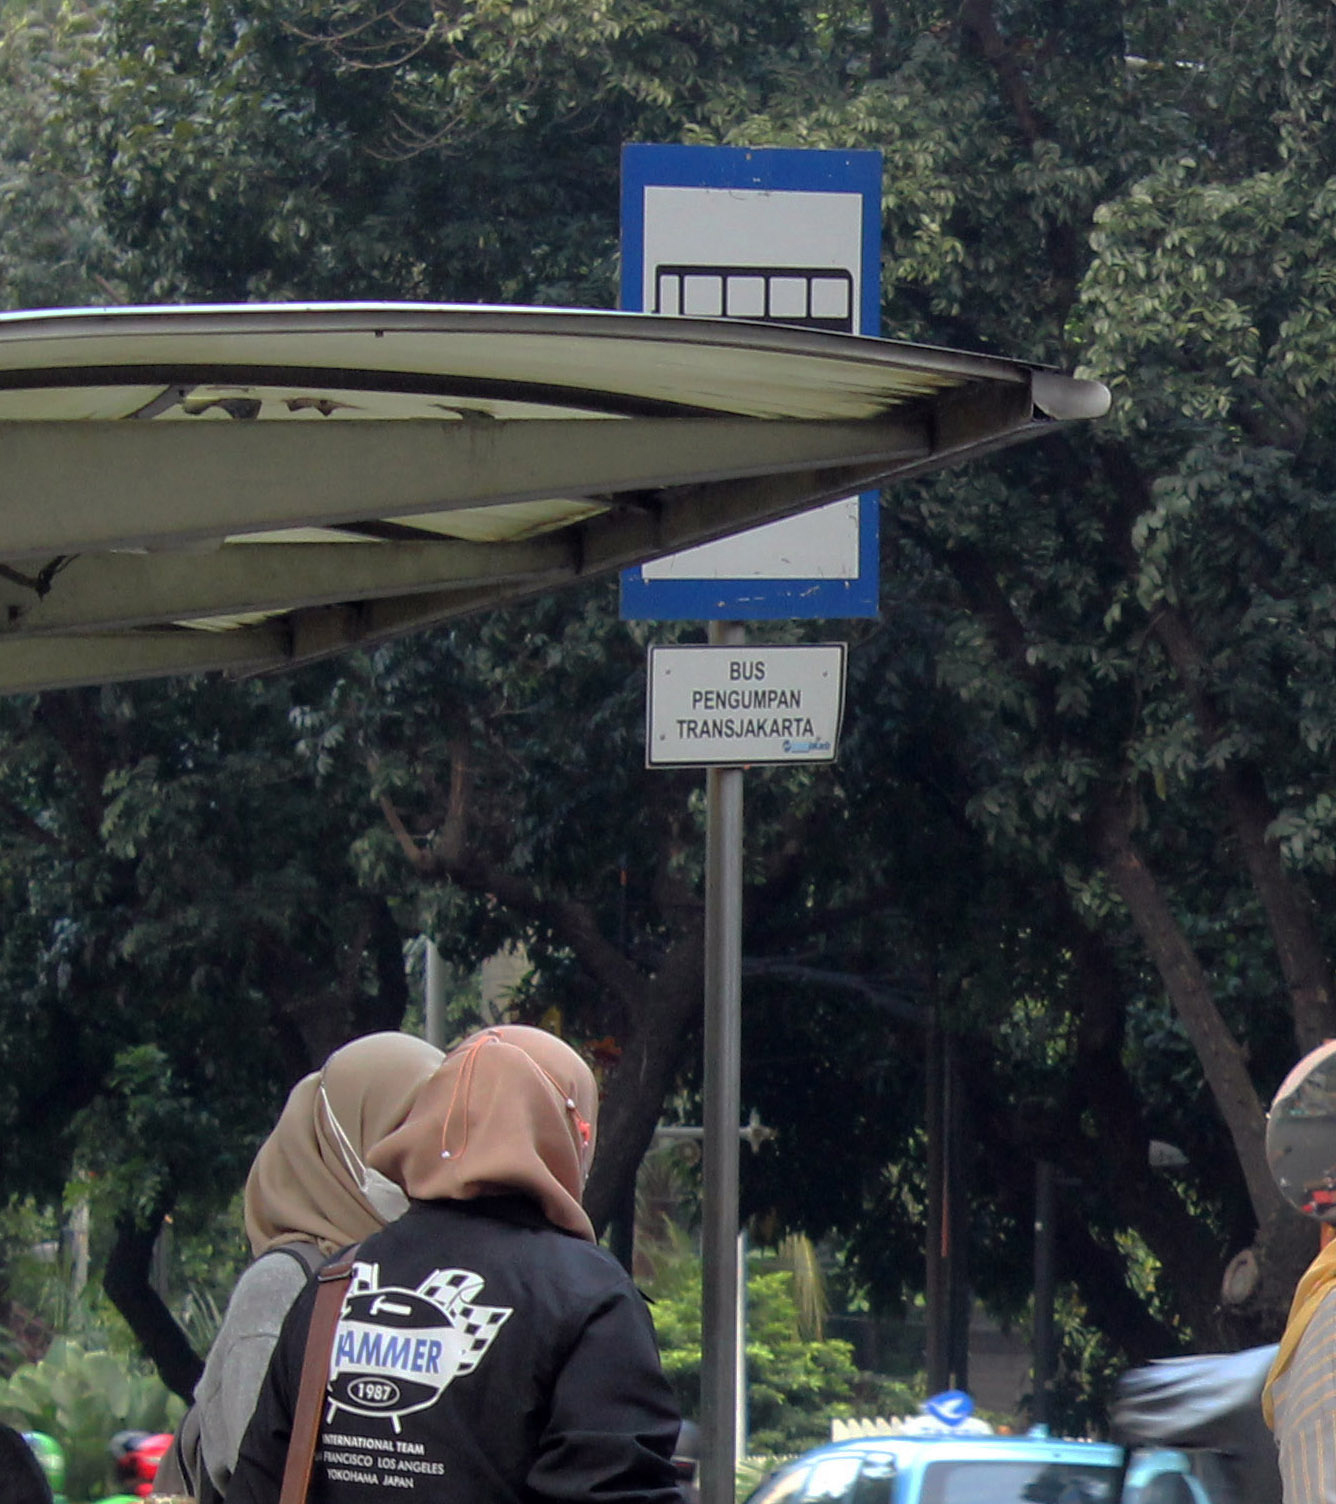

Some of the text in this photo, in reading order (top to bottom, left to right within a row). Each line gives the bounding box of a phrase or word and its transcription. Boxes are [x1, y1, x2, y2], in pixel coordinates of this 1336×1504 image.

[729, 661, 765, 681] BUS
[692, 690, 801, 710] PENGUMPAN
[676, 718, 814, 739] TRANSJAKARTA
[358, 1383, 392, 1400] 1987
[395, 1441, 425, 1456] TEAM
[323, 1450, 373, 1467] FRANCISCO
[377, 1457, 396, 1470] LOS
[397, 1460, 445, 1475] ANGELES
[327, 1468, 414, 1489] YOKOHAMA JAPAN
